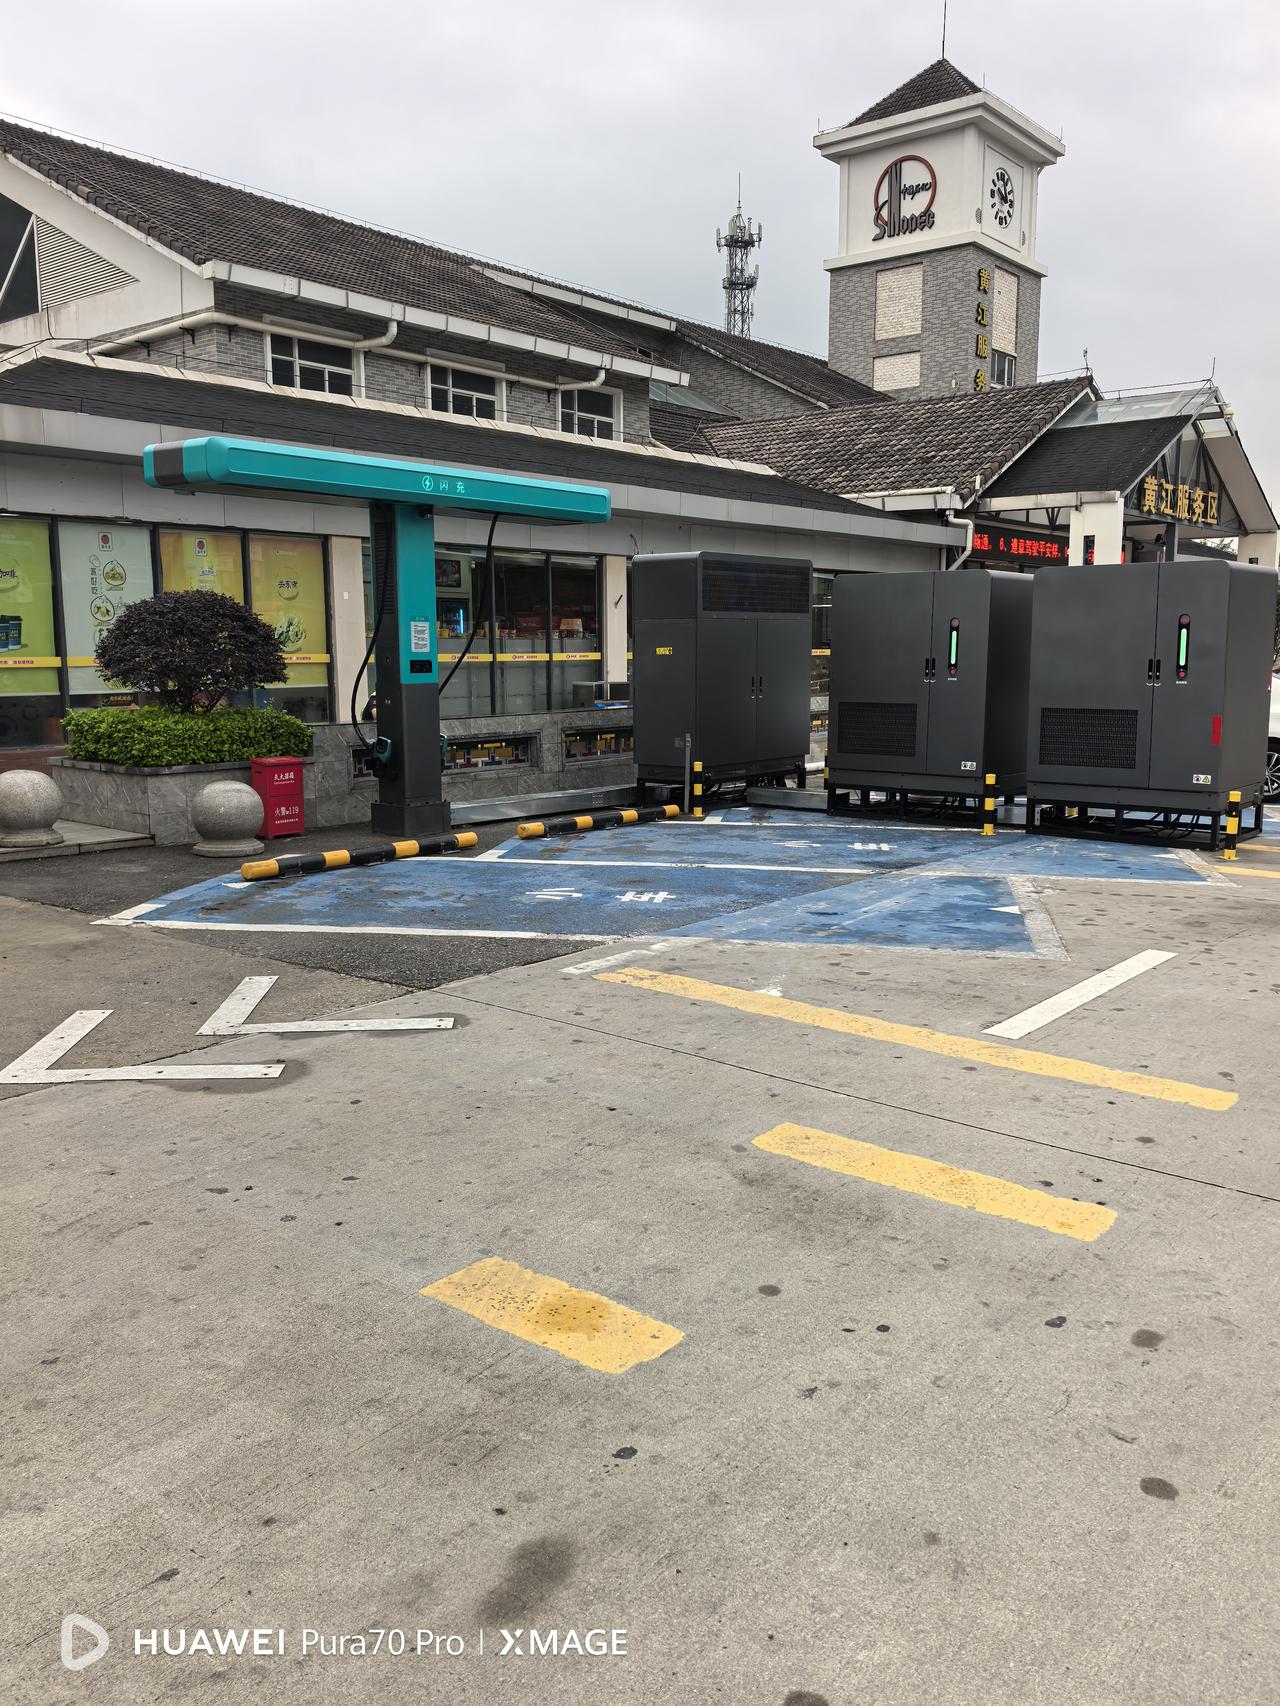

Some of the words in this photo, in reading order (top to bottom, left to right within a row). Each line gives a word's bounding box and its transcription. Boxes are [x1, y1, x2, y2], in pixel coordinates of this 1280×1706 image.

[975, 268, 990, 392] 黄江服务
[439, 479, 466, 494] 闪充
[1142, 474, 1219, 525] 黄江服务区
